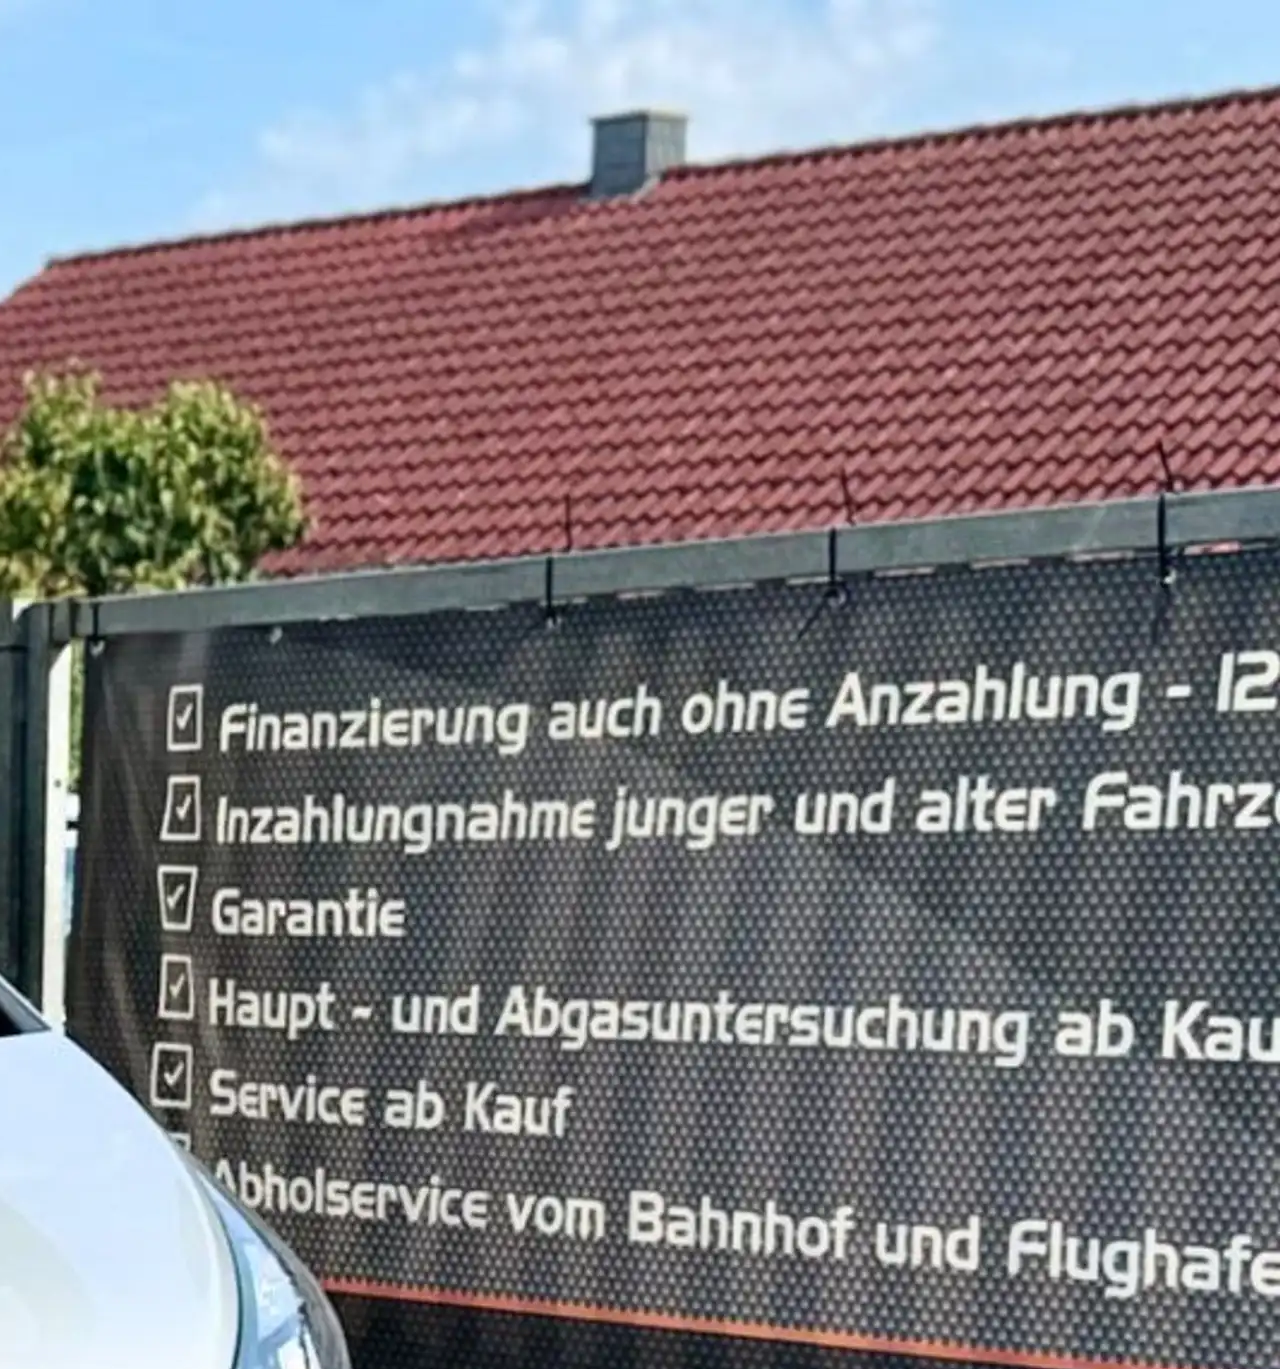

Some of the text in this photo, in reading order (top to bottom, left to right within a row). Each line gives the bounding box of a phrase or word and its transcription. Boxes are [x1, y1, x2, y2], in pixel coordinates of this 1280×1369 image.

[219, 698, 530, 755] Finanzierung
[548, 684, 663, 739] auch
[680, 678, 810, 735] ohne
[825, 662, 1143, 732] Anzahlung
[215, 769, 1280, 854] Inzahlungnahme junger und alter Fahrz
[211, 886, 407, 938] Garantie
[207, 978, 336, 1040] Haupt
[390, 984, 480, 1036] und
[493, 984, 1030, 1067] Abgasuntersuchung
[1054, 998, 1135, 1057] ab
[208, 1068, 576, 1138] Service ab Kauf
[506, 1191, 606, 1241] vom
[628, 1190, 856, 1260] Bahnhof
[874, 1213, 981, 1273] und
